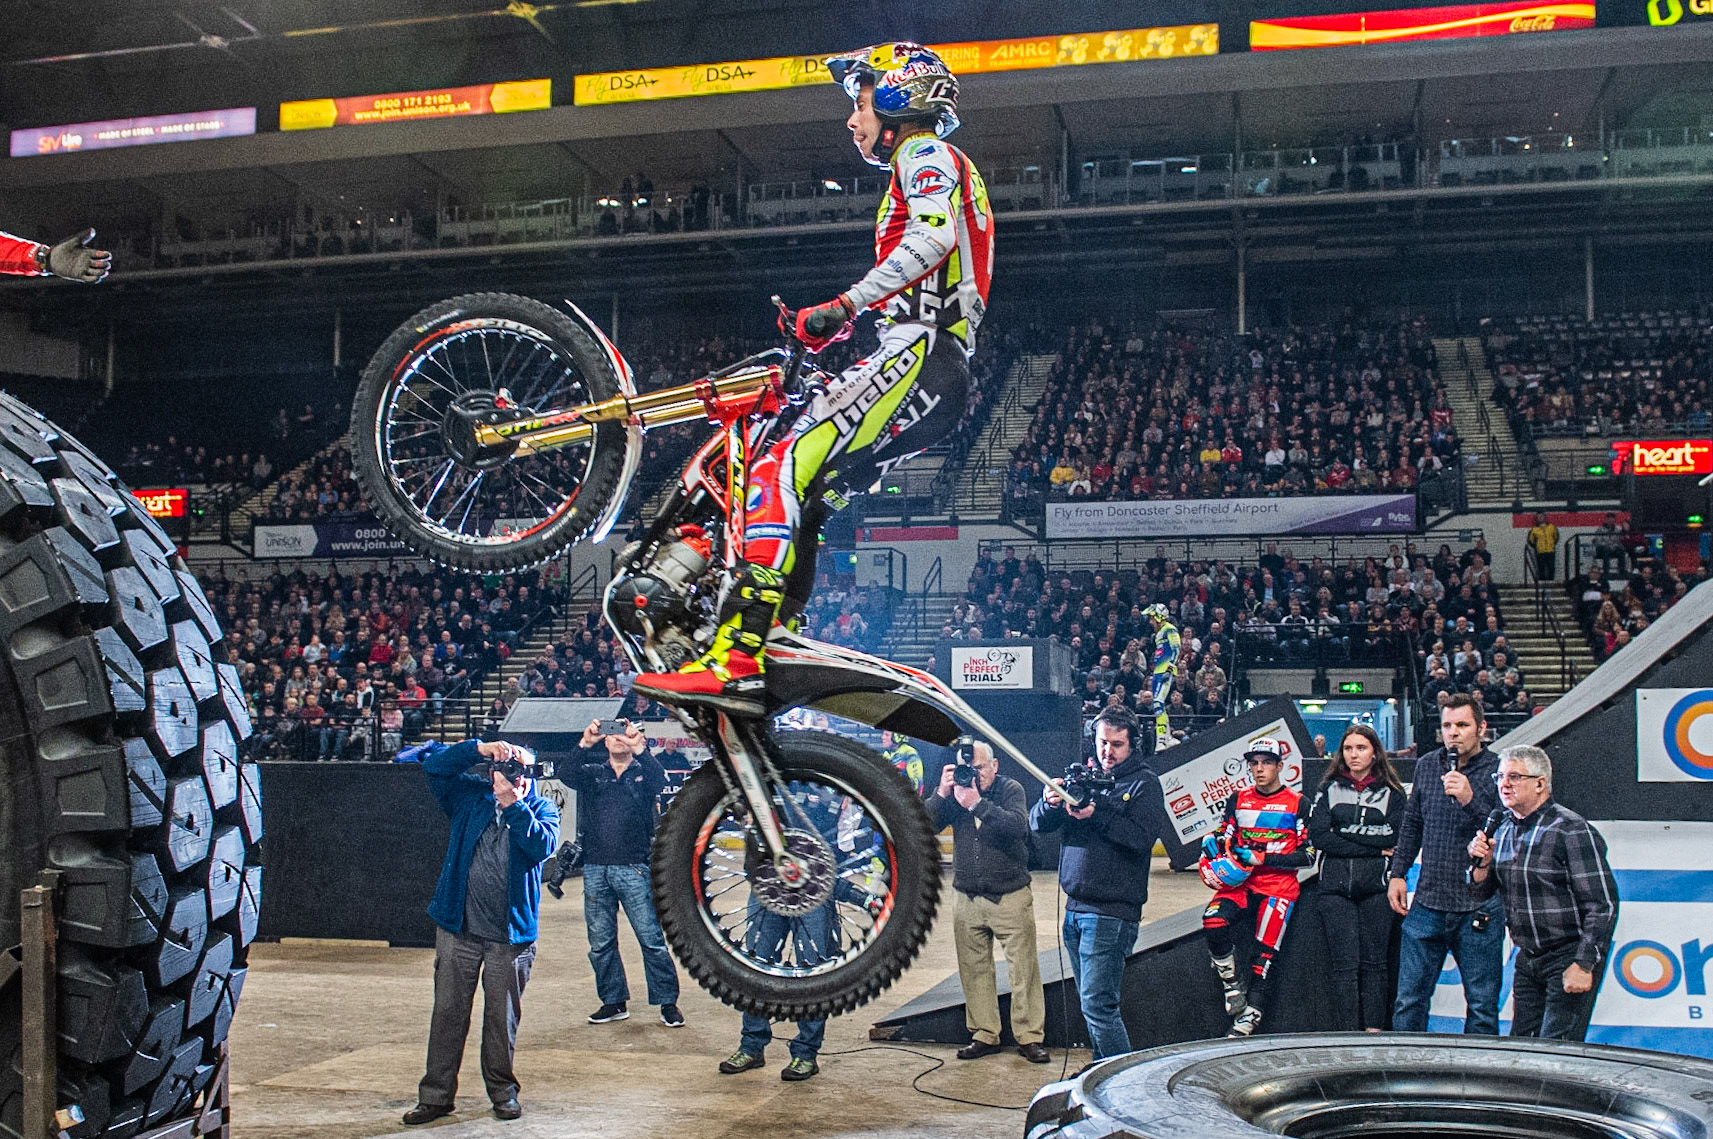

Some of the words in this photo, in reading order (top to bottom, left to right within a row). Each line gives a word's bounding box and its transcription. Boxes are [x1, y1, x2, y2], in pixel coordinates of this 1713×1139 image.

[938, 46, 979, 62] EERING
[990, 42, 1051, 60] AMRC
[804, 58, 830, 74] DS
[886, 66, 918, 87] Red
[918, 61, 947, 78] Bull
[586, 76, 609, 100] Fly
[610, 74, 649, 91] DSA
[682, 66, 704, 92] Fly
[706, 65, 746, 82] DSA
[403, 95, 423, 107] 171
[354, 101, 472, 120] www.join.unison.org.uk
[1634, 443, 1695, 466] heart
[1054, 507, 1071, 520] Fly
[1074, 506, 1104, 517] from
[1107, 505, 1171, 517] Doncaster
[1175, 503, 1230, 516] Sheffield
[1233, 503, 1279, 516] Airport
[354, 528, 387, 540] 0800
[963, 663, 1000, 674] PERFECT
[969, 656, 988, 666] INCH
[963, 673, 1003, 682] TRIALS
[1200, 777, 1248, 806] PERFECT
[1204, 775, 1231, 793] INCH
